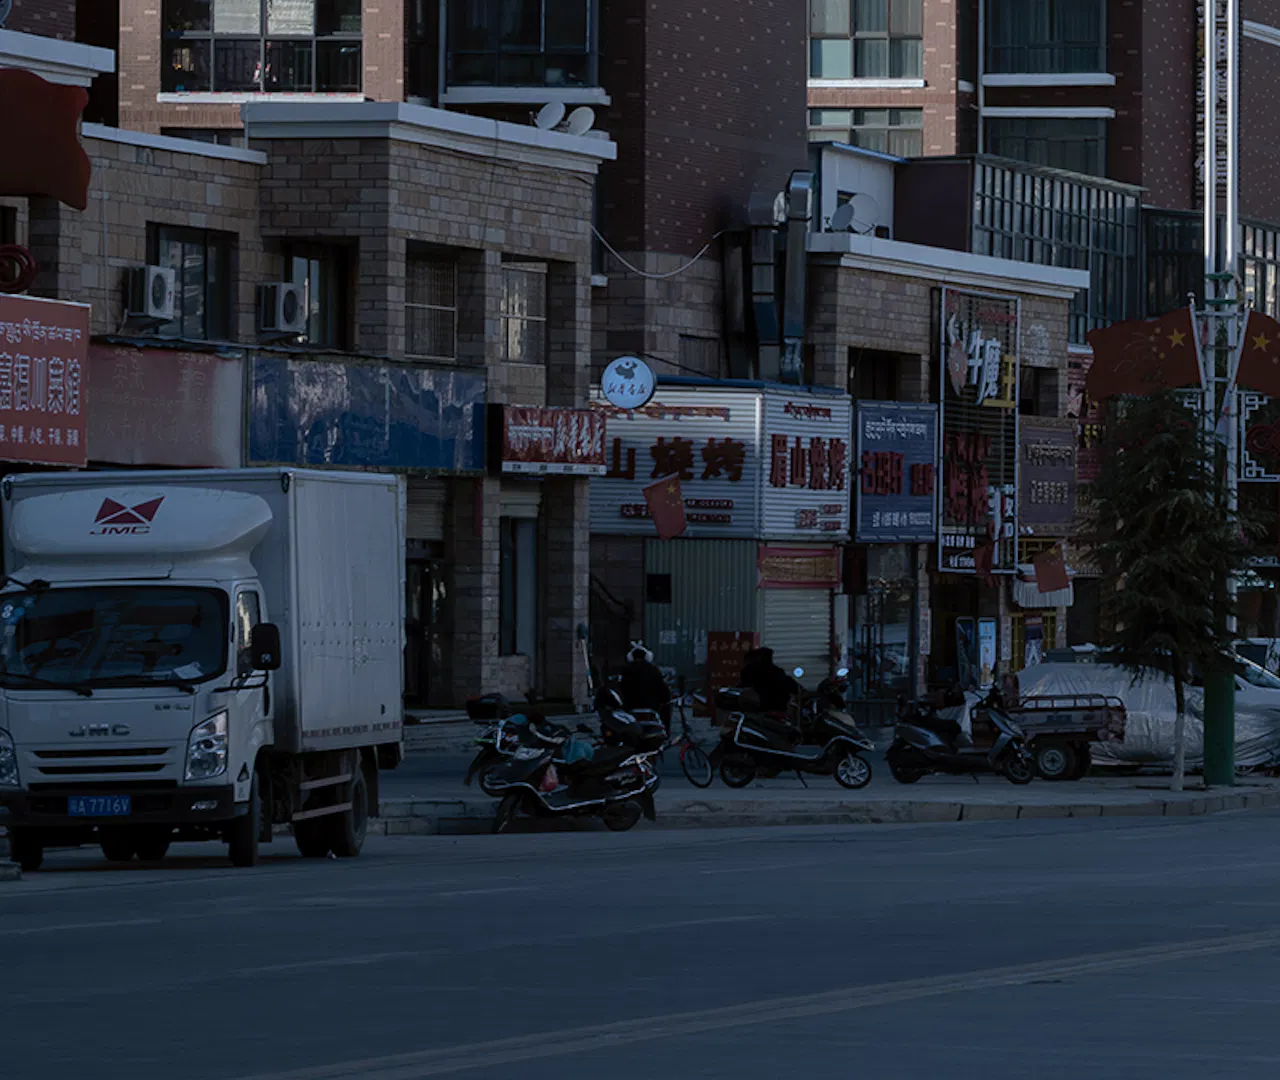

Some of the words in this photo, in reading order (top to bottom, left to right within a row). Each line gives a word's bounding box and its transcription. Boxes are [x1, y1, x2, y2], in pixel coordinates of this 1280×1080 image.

[769, 433, 846, 491] 眉山烧烤
[89, 525, 151, 535] JMC
[69, 723, 131, 737] JMC
